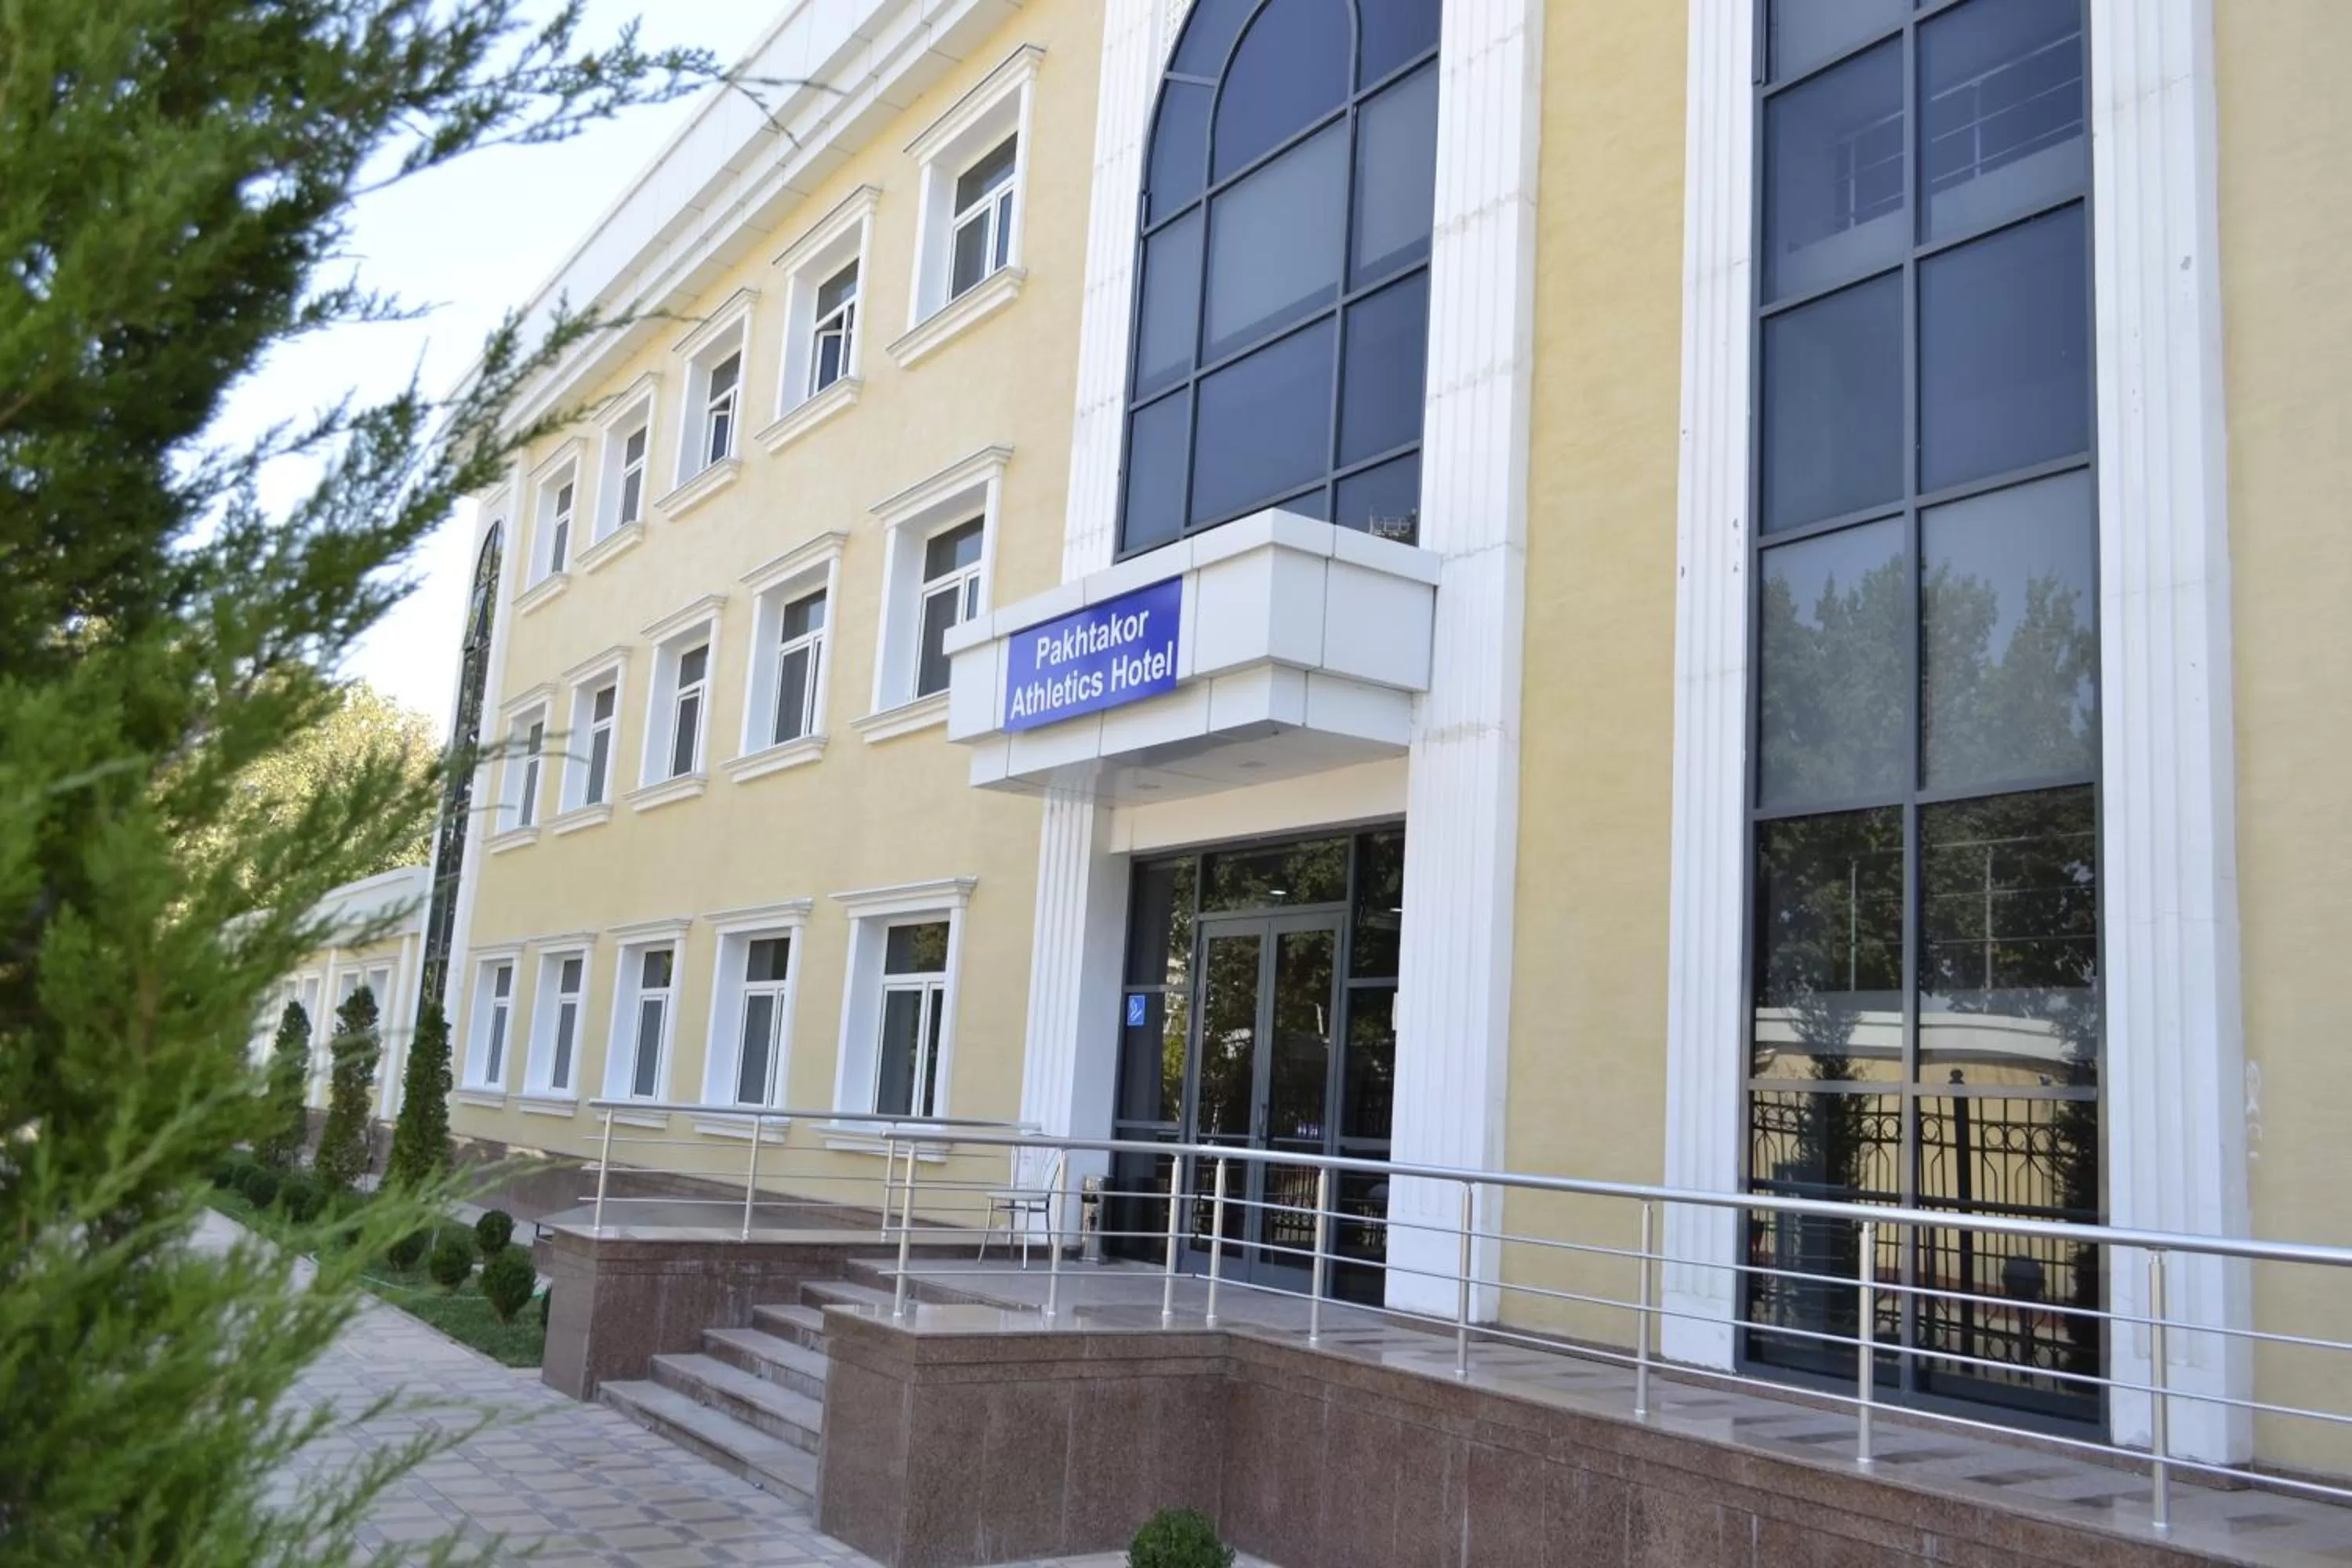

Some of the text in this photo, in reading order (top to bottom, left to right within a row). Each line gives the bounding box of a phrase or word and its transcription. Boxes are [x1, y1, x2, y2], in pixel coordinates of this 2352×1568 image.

[1036, 610, 1149, 669] Pakhtakor
[1011, 641, 1174, 720] Athletics Hotel
